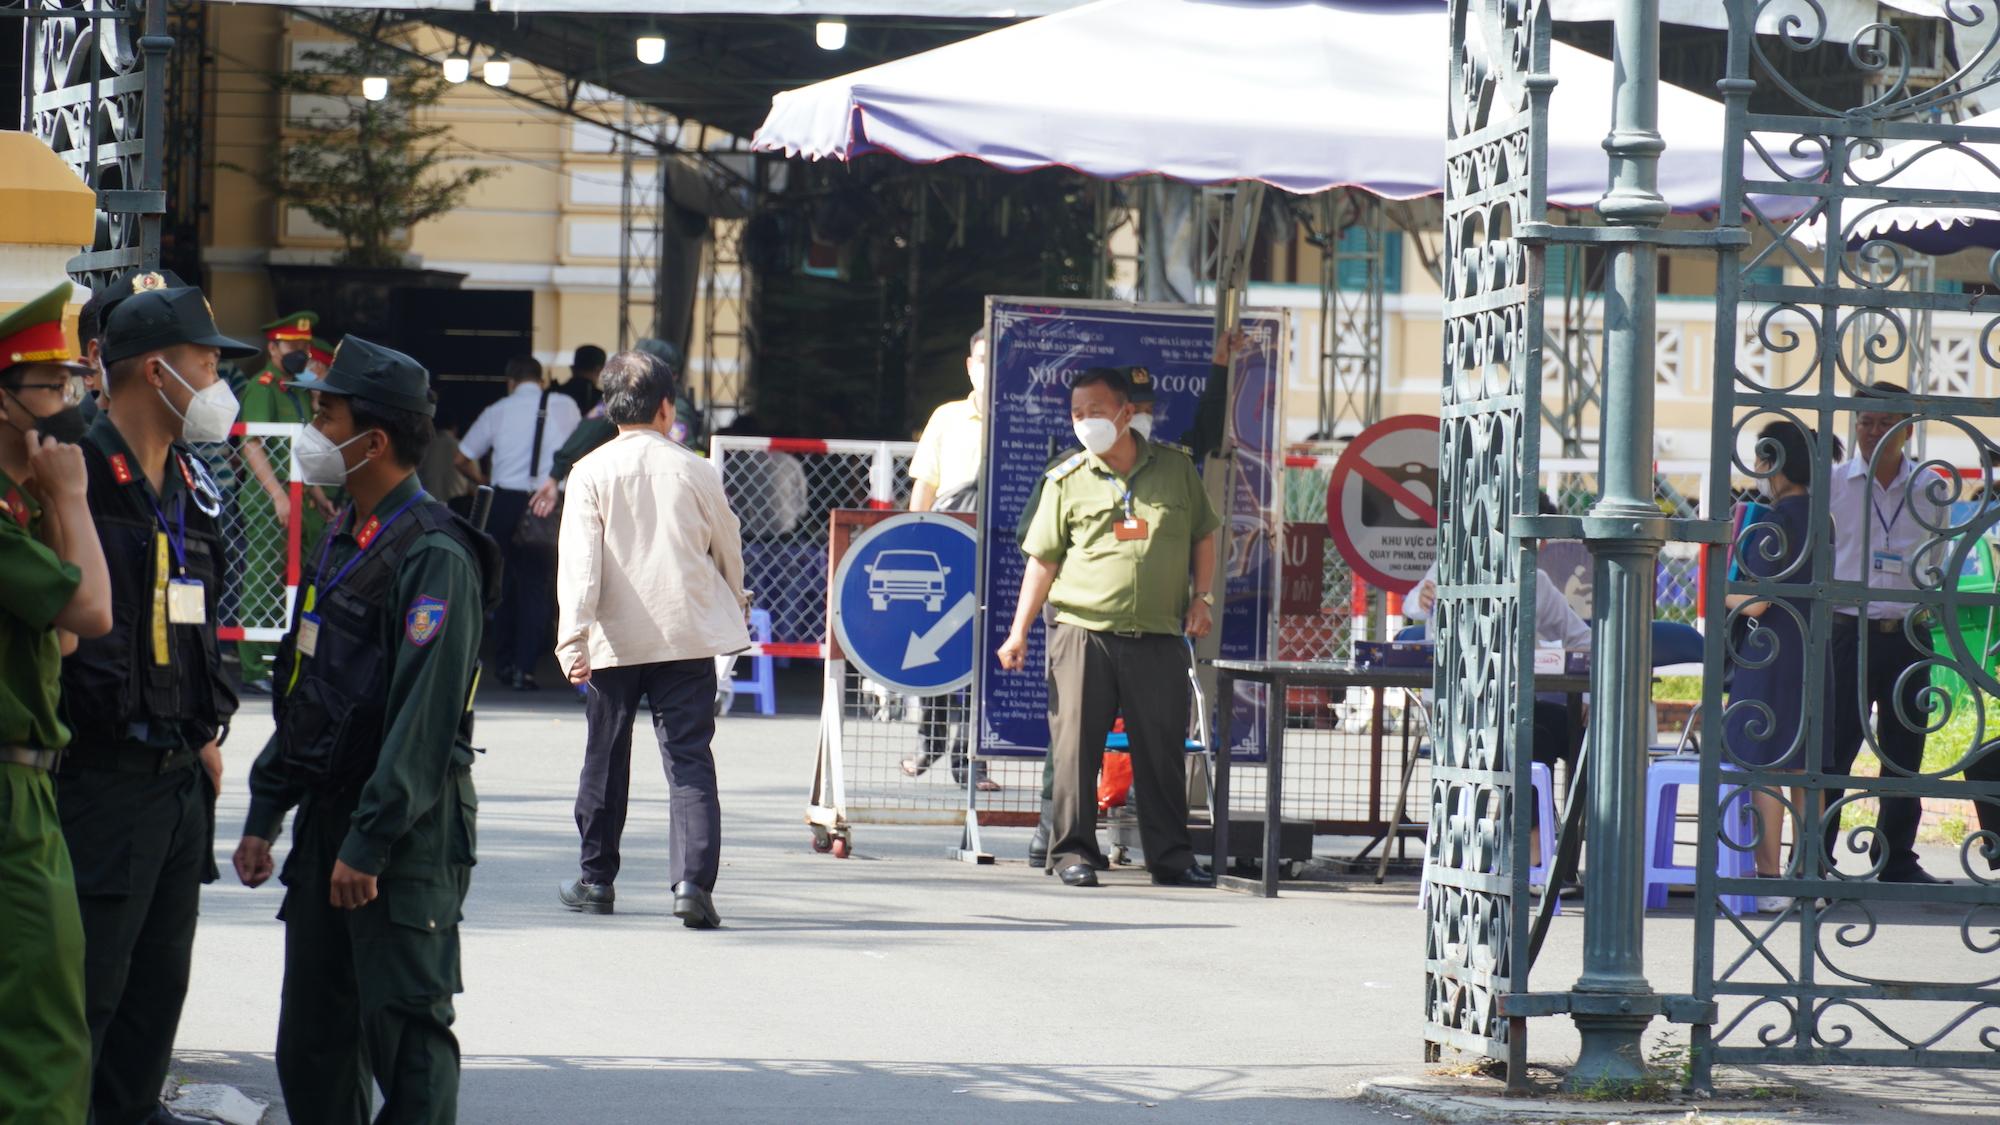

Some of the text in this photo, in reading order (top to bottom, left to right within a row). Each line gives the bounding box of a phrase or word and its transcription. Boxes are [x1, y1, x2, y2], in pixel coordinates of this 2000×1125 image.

[1161, 374, 1186, 393] CƠ
[1381, 535, 1402, 546] KHU
[1404, 534, 1425, 548] VỰC
[1369, 549, 1390, 560] QUAY
[1393, 550, 1416, 561] PHIM,
